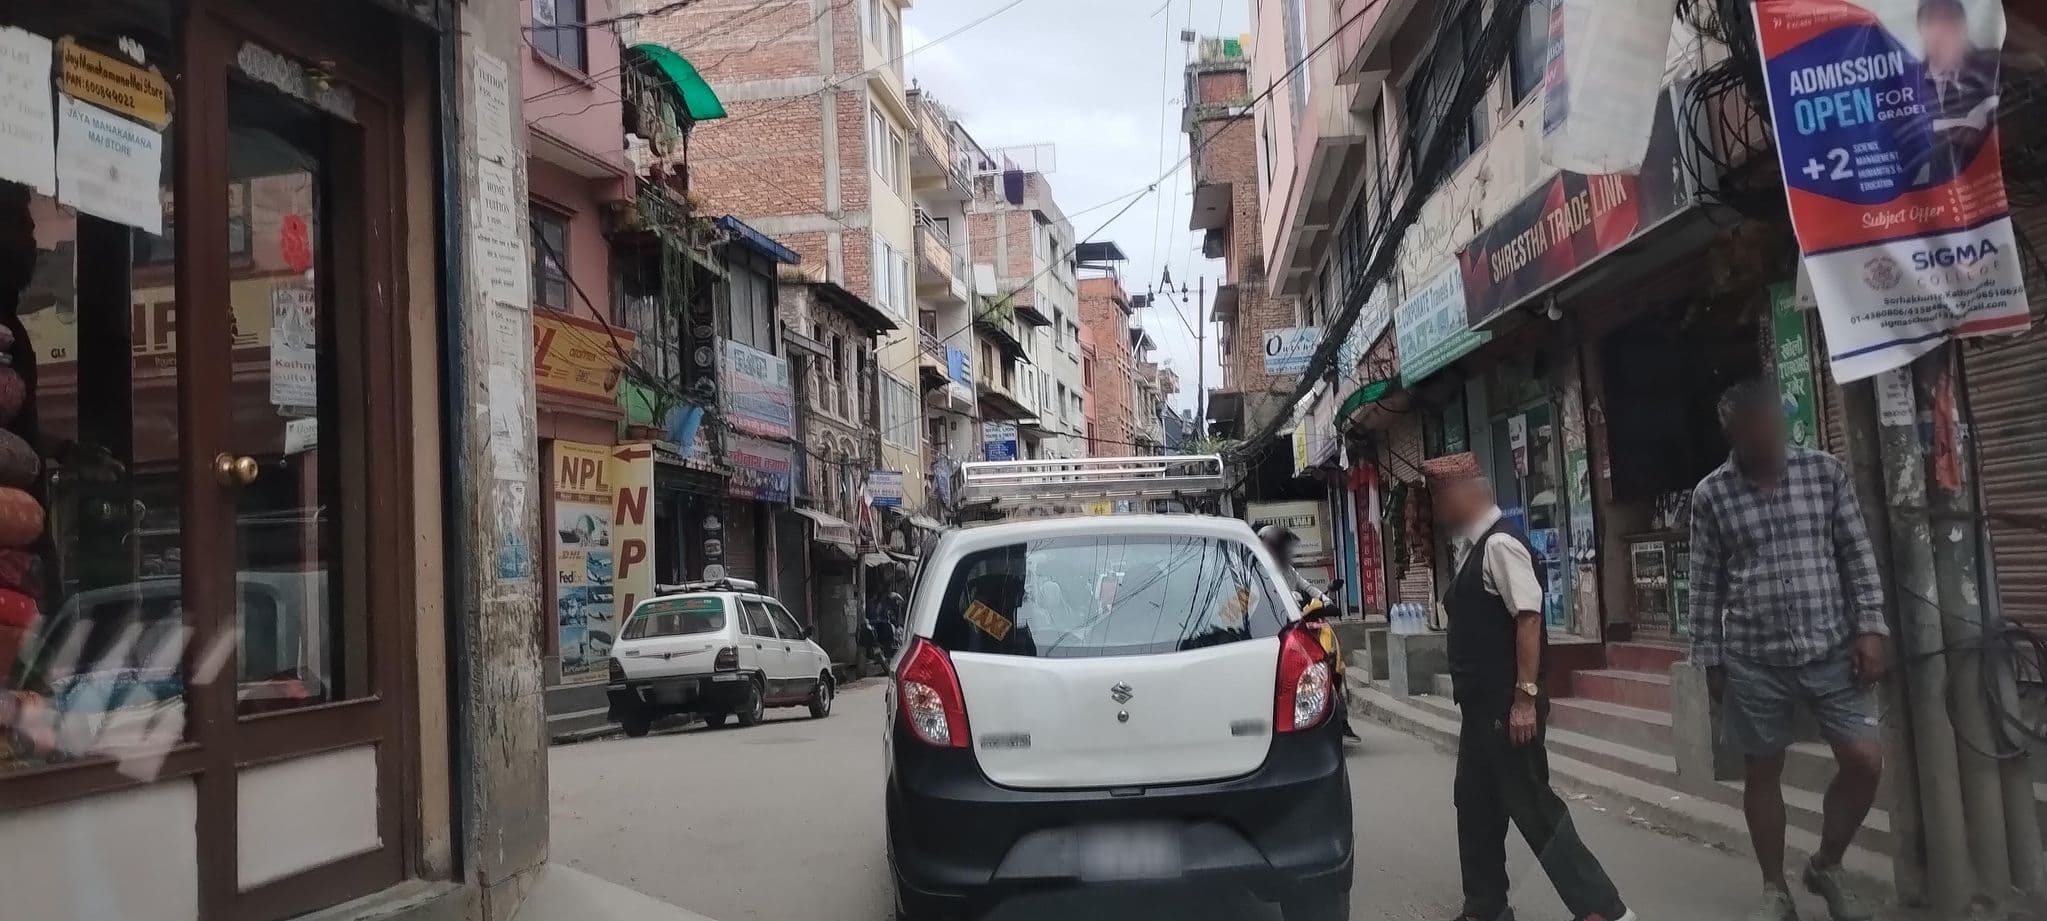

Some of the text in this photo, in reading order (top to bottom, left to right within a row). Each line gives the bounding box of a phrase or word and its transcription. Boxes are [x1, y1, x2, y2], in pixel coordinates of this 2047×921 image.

[1790, 51, 1905, 96] ADMISSION
[1794, 87, 1875, 135] OPEN
[1875, 87, 1914, 107] FOR
[1802, 148, 1854, 181] +2
[1490, 219, 1549, 284] SHRESTHA
[1546, 188, 1591, 247] TRADE
[1590, 173, 1628, 220] LINK
[1862, 204, 1945, 229] Subject Offer
[1912, 238, 1998, 271] SIGMA
[560, 455, 609, 492] NPL
[559, 570, 584, 584] FedEx
[968, 603, 1009, 636] TAXI
